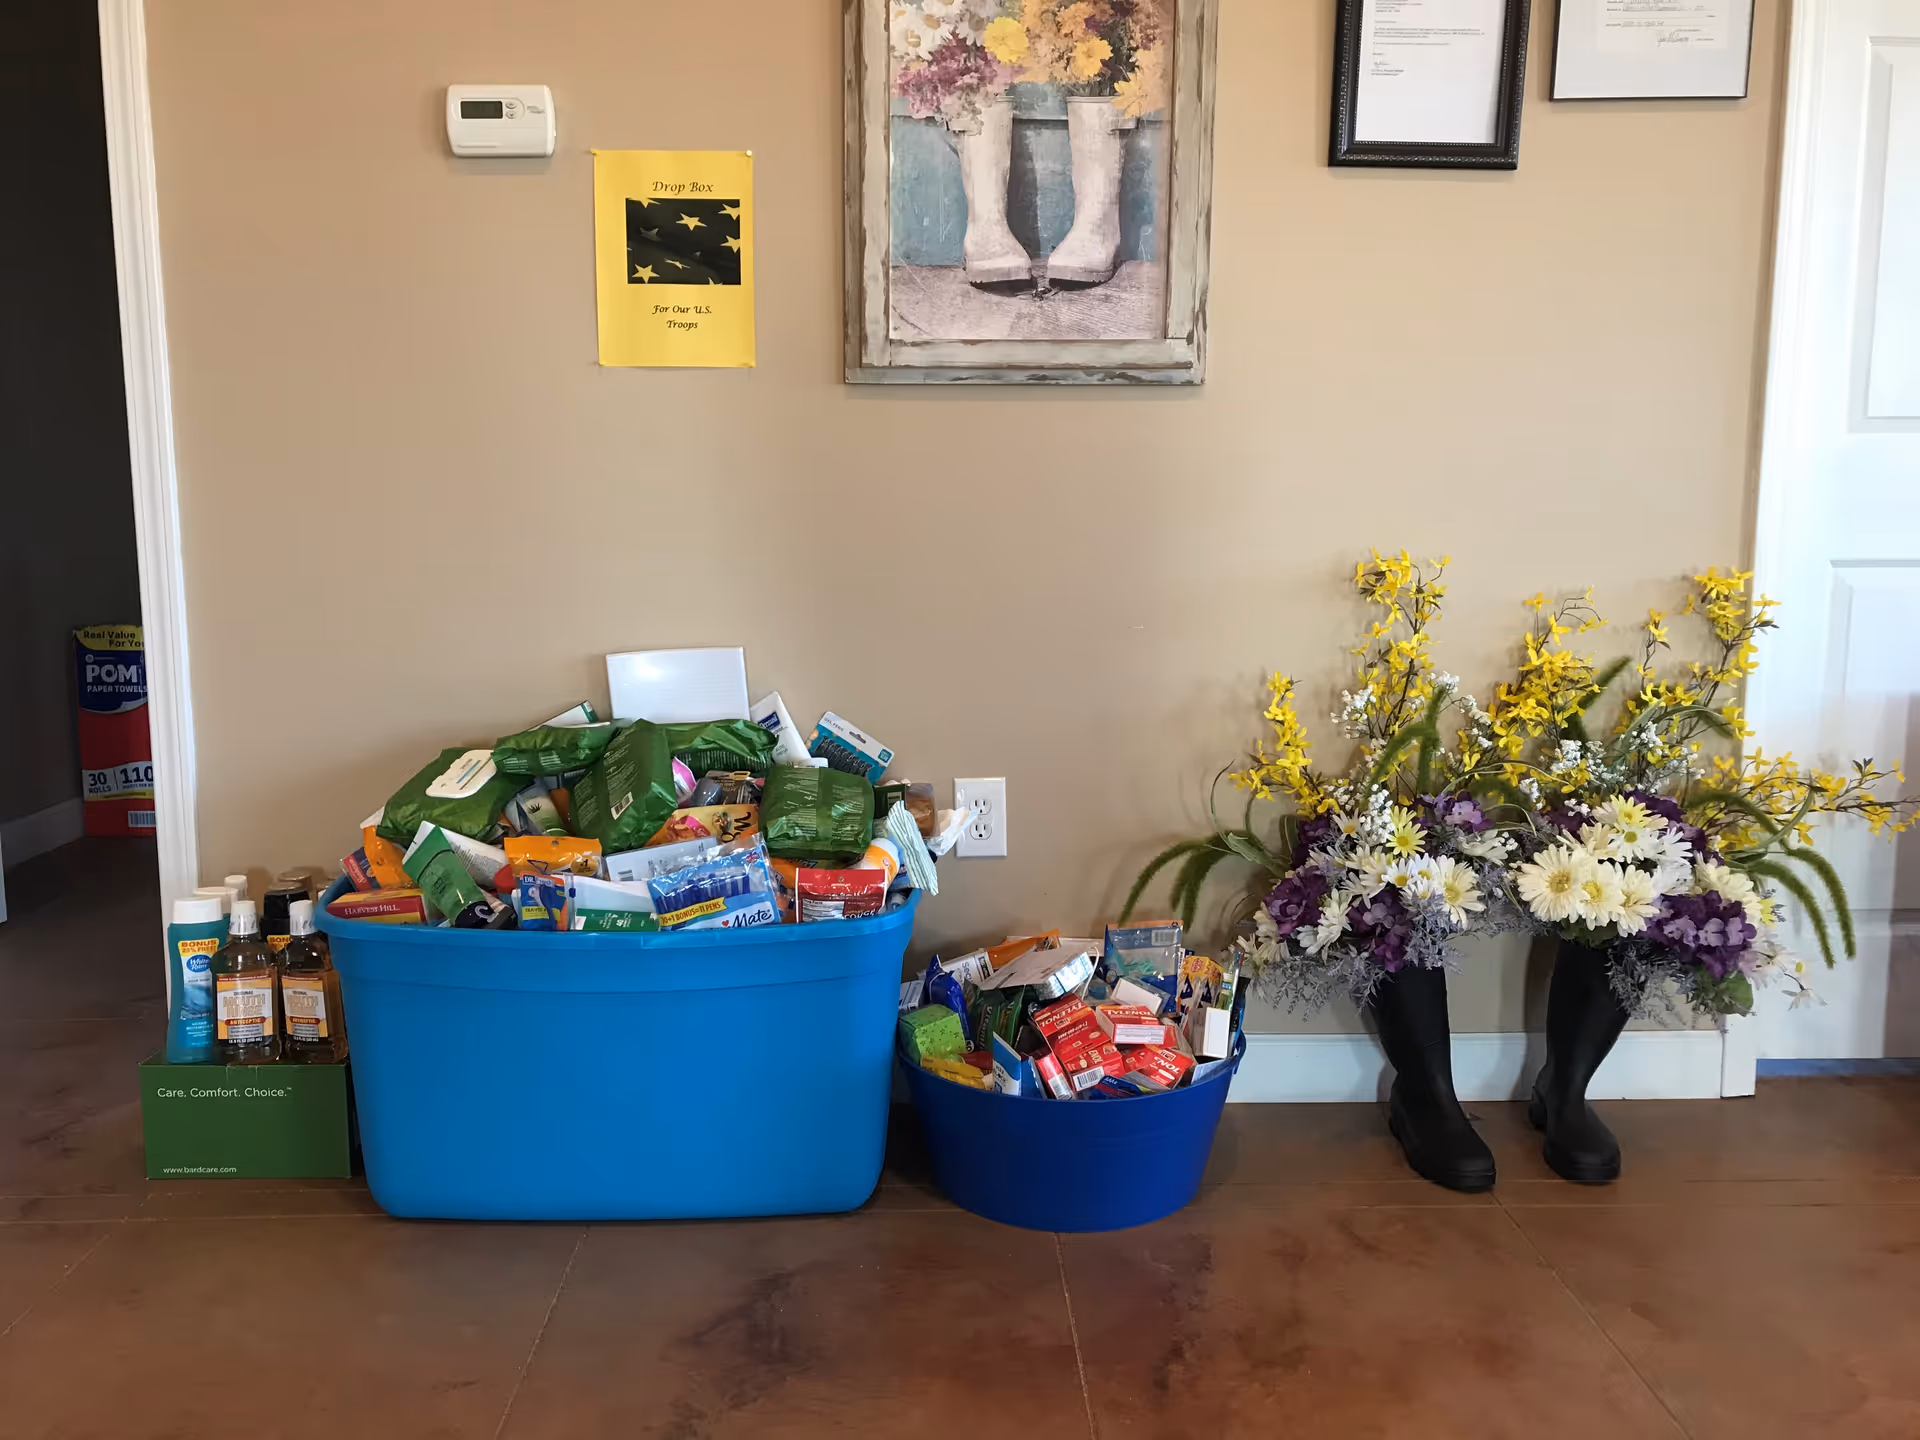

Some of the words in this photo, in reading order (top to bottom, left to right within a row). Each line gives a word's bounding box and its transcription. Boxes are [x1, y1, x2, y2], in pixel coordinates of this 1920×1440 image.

[652, 181, 685, 196] Drop
[689, 182, 714, 192] Box
[651, 304, 670, 315] For
[672, 304, 691, 314] Our
[693, 305, 712, 314] U.S.
[666, 319, 698, 331] Troops
[83, 630, 105, 639] Real
[107, 630, 136, 639] Value
[109, 640, 126, 648] For
[86, 664, 138, 683] POM
[87, 685, 113, 693] PAPER
[88, 771, 107, 787] 30
[120, 765, 153, 784] 110
[344, 905, 378, 915] HARVEST
[379, 904, 399, 912] HILL
[706, 902, 721, 911] PENS
[732, 909, 772, 928] Mate
[181, 939, 217, 948] BONUS
[1040, 1001, 1086, 1027] TYLENOL
[157, 1087, 187, 1098] Care.
[190, 1087, 241, 1098] Comfort.
[163, 1166, 237, 1174] www.bardcare.com
